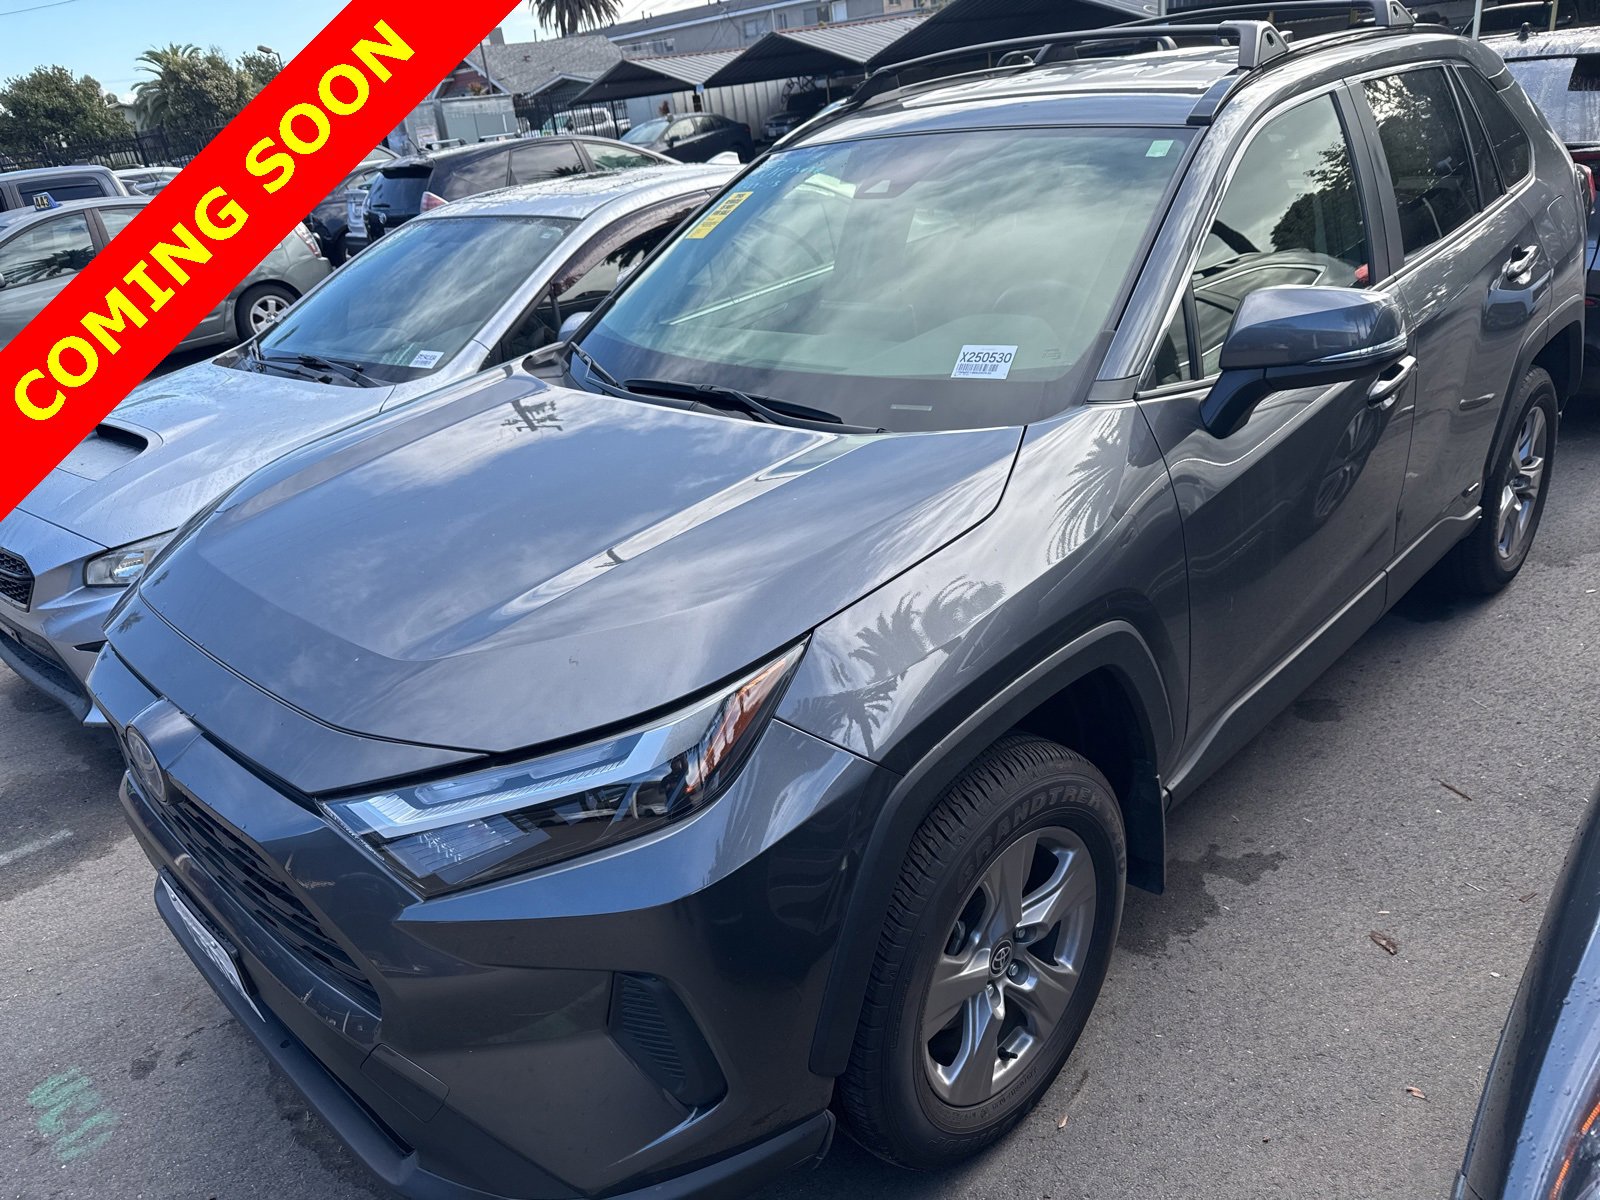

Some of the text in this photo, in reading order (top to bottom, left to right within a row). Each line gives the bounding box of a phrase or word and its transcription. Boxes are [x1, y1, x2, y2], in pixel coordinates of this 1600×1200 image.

[35, 196, 50, 208] 443
[960, 351, 1012, 363] X250530
[956, 785, 1103, 895] GRANDTREK
